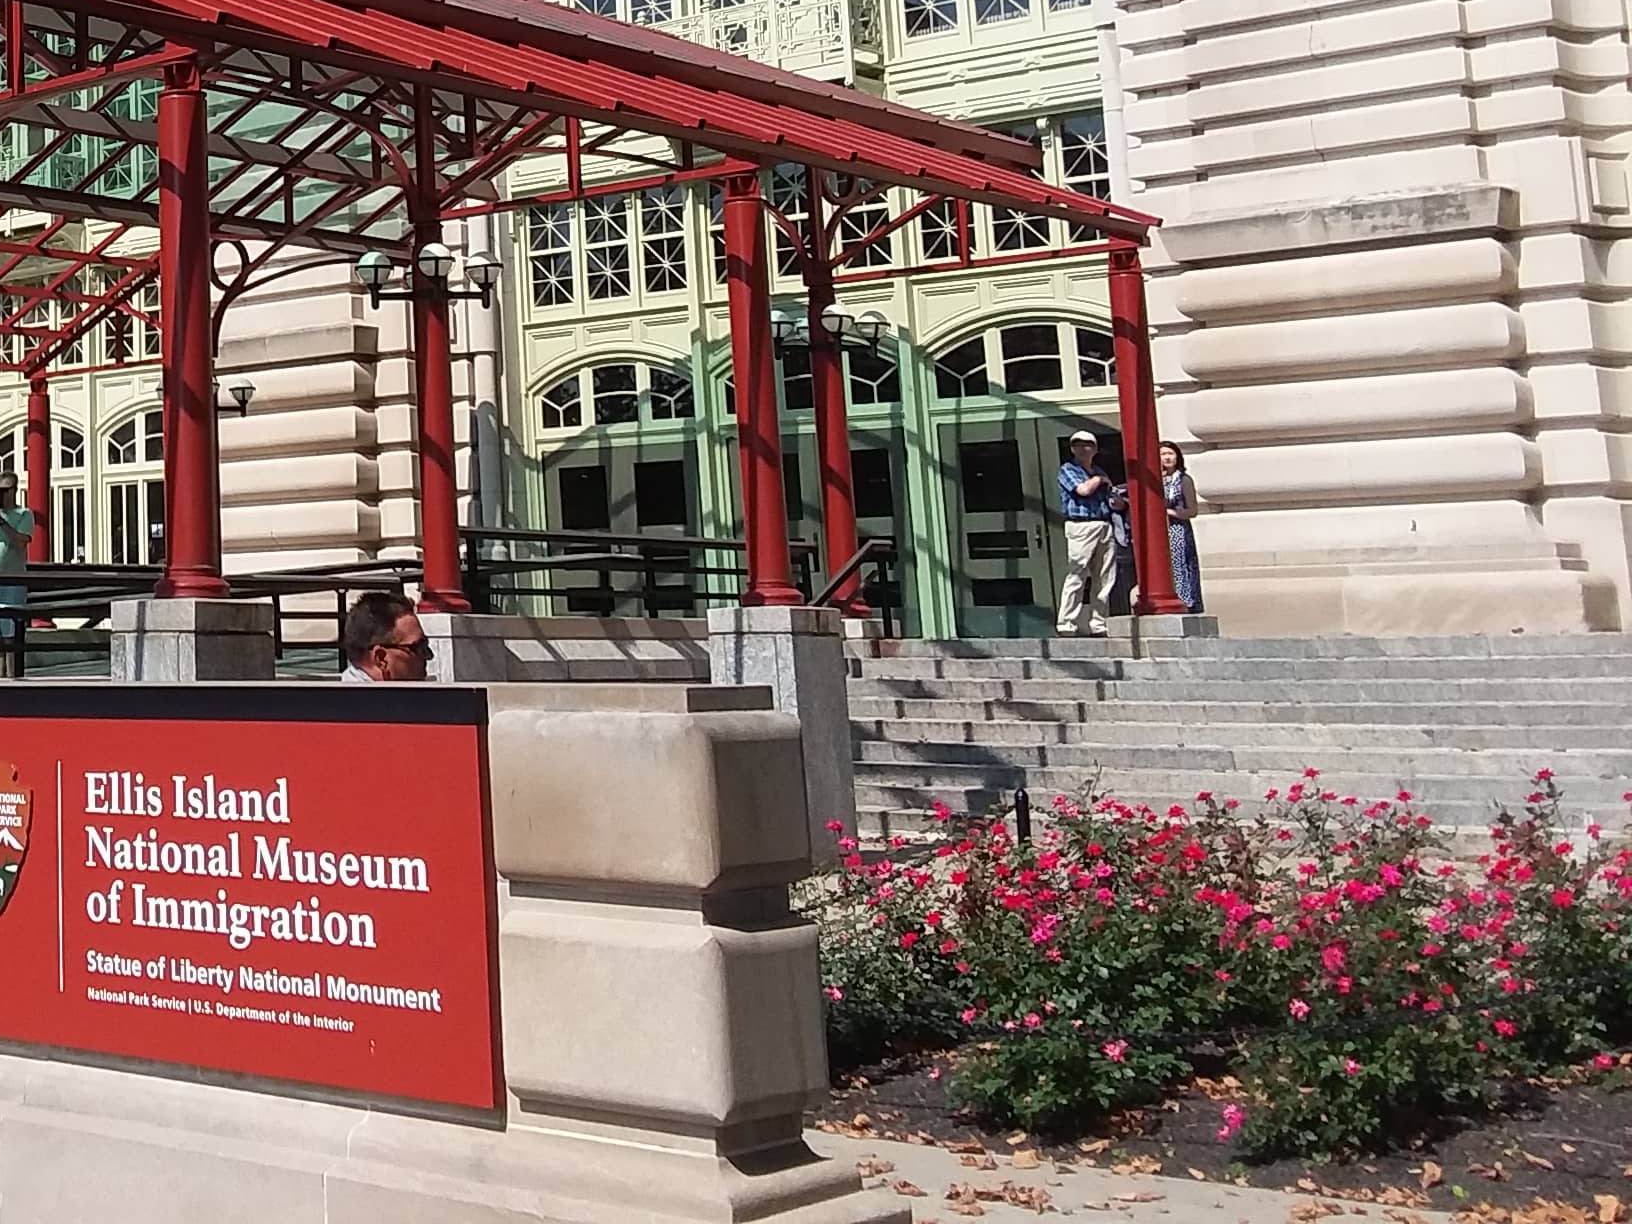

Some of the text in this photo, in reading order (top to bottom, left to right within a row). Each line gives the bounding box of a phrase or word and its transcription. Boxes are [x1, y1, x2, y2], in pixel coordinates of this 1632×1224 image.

[84, 771, 291, 824] Ellis Island
[84, 825, 431, 892] National Museum
[86, 879, 377, 950] of Immigration
[86, 949, 442, 1013] Statue of Liberty National Monument
[87, 986, 355, 1032] National Park Service U.S. Department of the Interior
